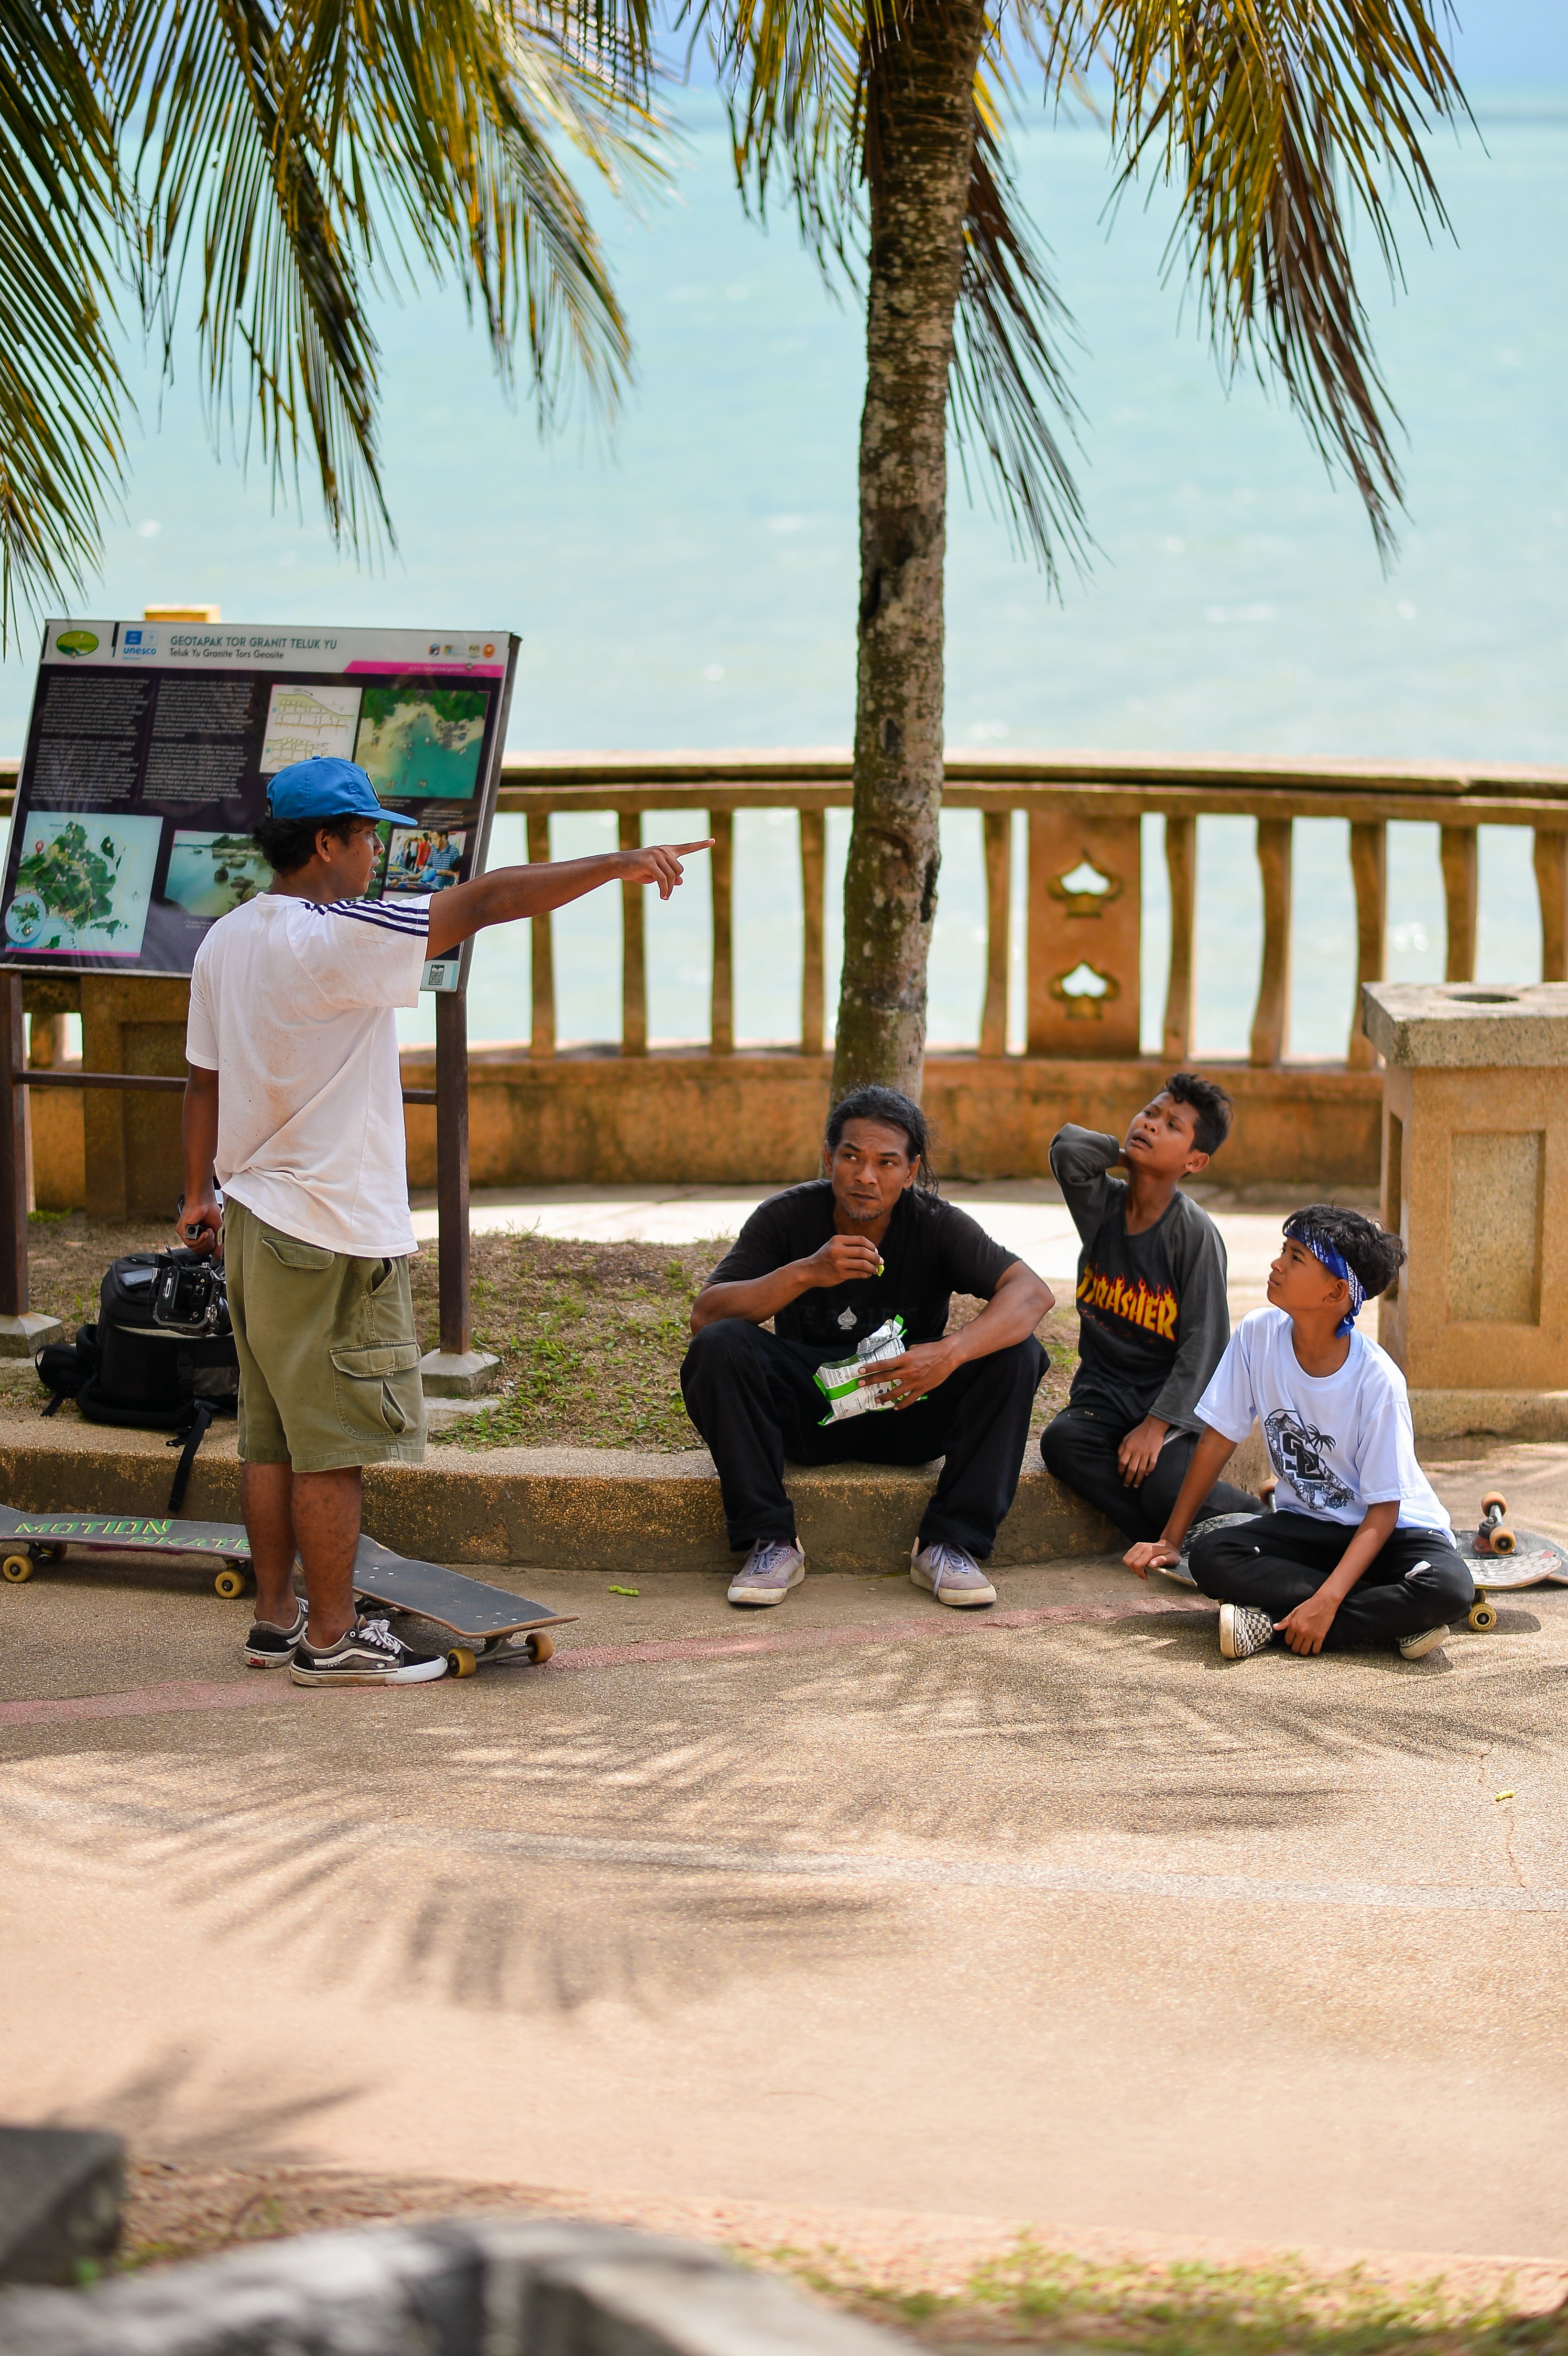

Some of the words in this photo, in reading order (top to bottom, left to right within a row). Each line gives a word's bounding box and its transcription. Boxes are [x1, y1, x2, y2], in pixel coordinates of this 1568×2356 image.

[171, 636, 223, 646] GEOTAPAK
[227, 637, 246, 646] TOR
[250, 638, 287, 647] GRANIT
[291, 639, 321, 649] TELUK
[325, 640, 338, 649] YU
[170, 648, 189, 656] Teluk
[192, 649, 201, 657] Yu
[203, 649, 233, 657] Granite
[236, 650, 250, 658] Tors
[254, 650, 284, 659] Geosite
[15, 1520, 173, 1534] MOTION
